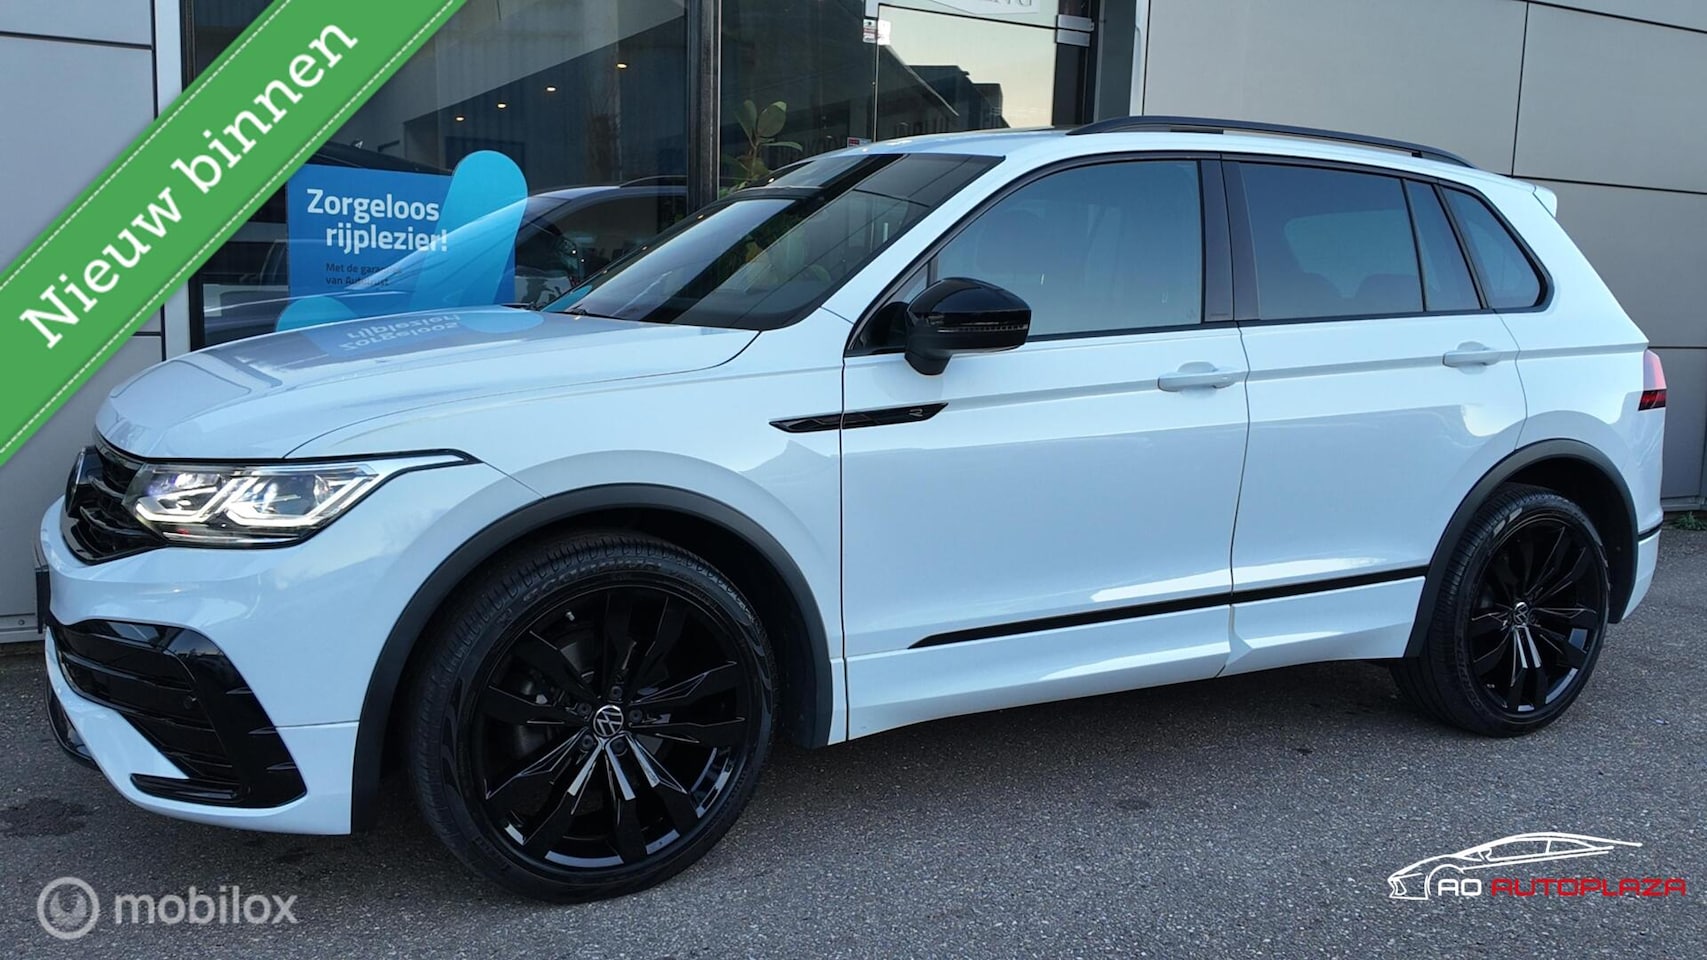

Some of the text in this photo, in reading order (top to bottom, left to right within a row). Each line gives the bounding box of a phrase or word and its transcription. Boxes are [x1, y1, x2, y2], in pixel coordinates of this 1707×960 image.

[307, 188, 440, 224] Zorgeloos
[325, 222, 448, 255] rijplezier!
[326, 263, 345, 273] Met
[346, 263, 359, 273] de
[326, 277, 343, 285] van
